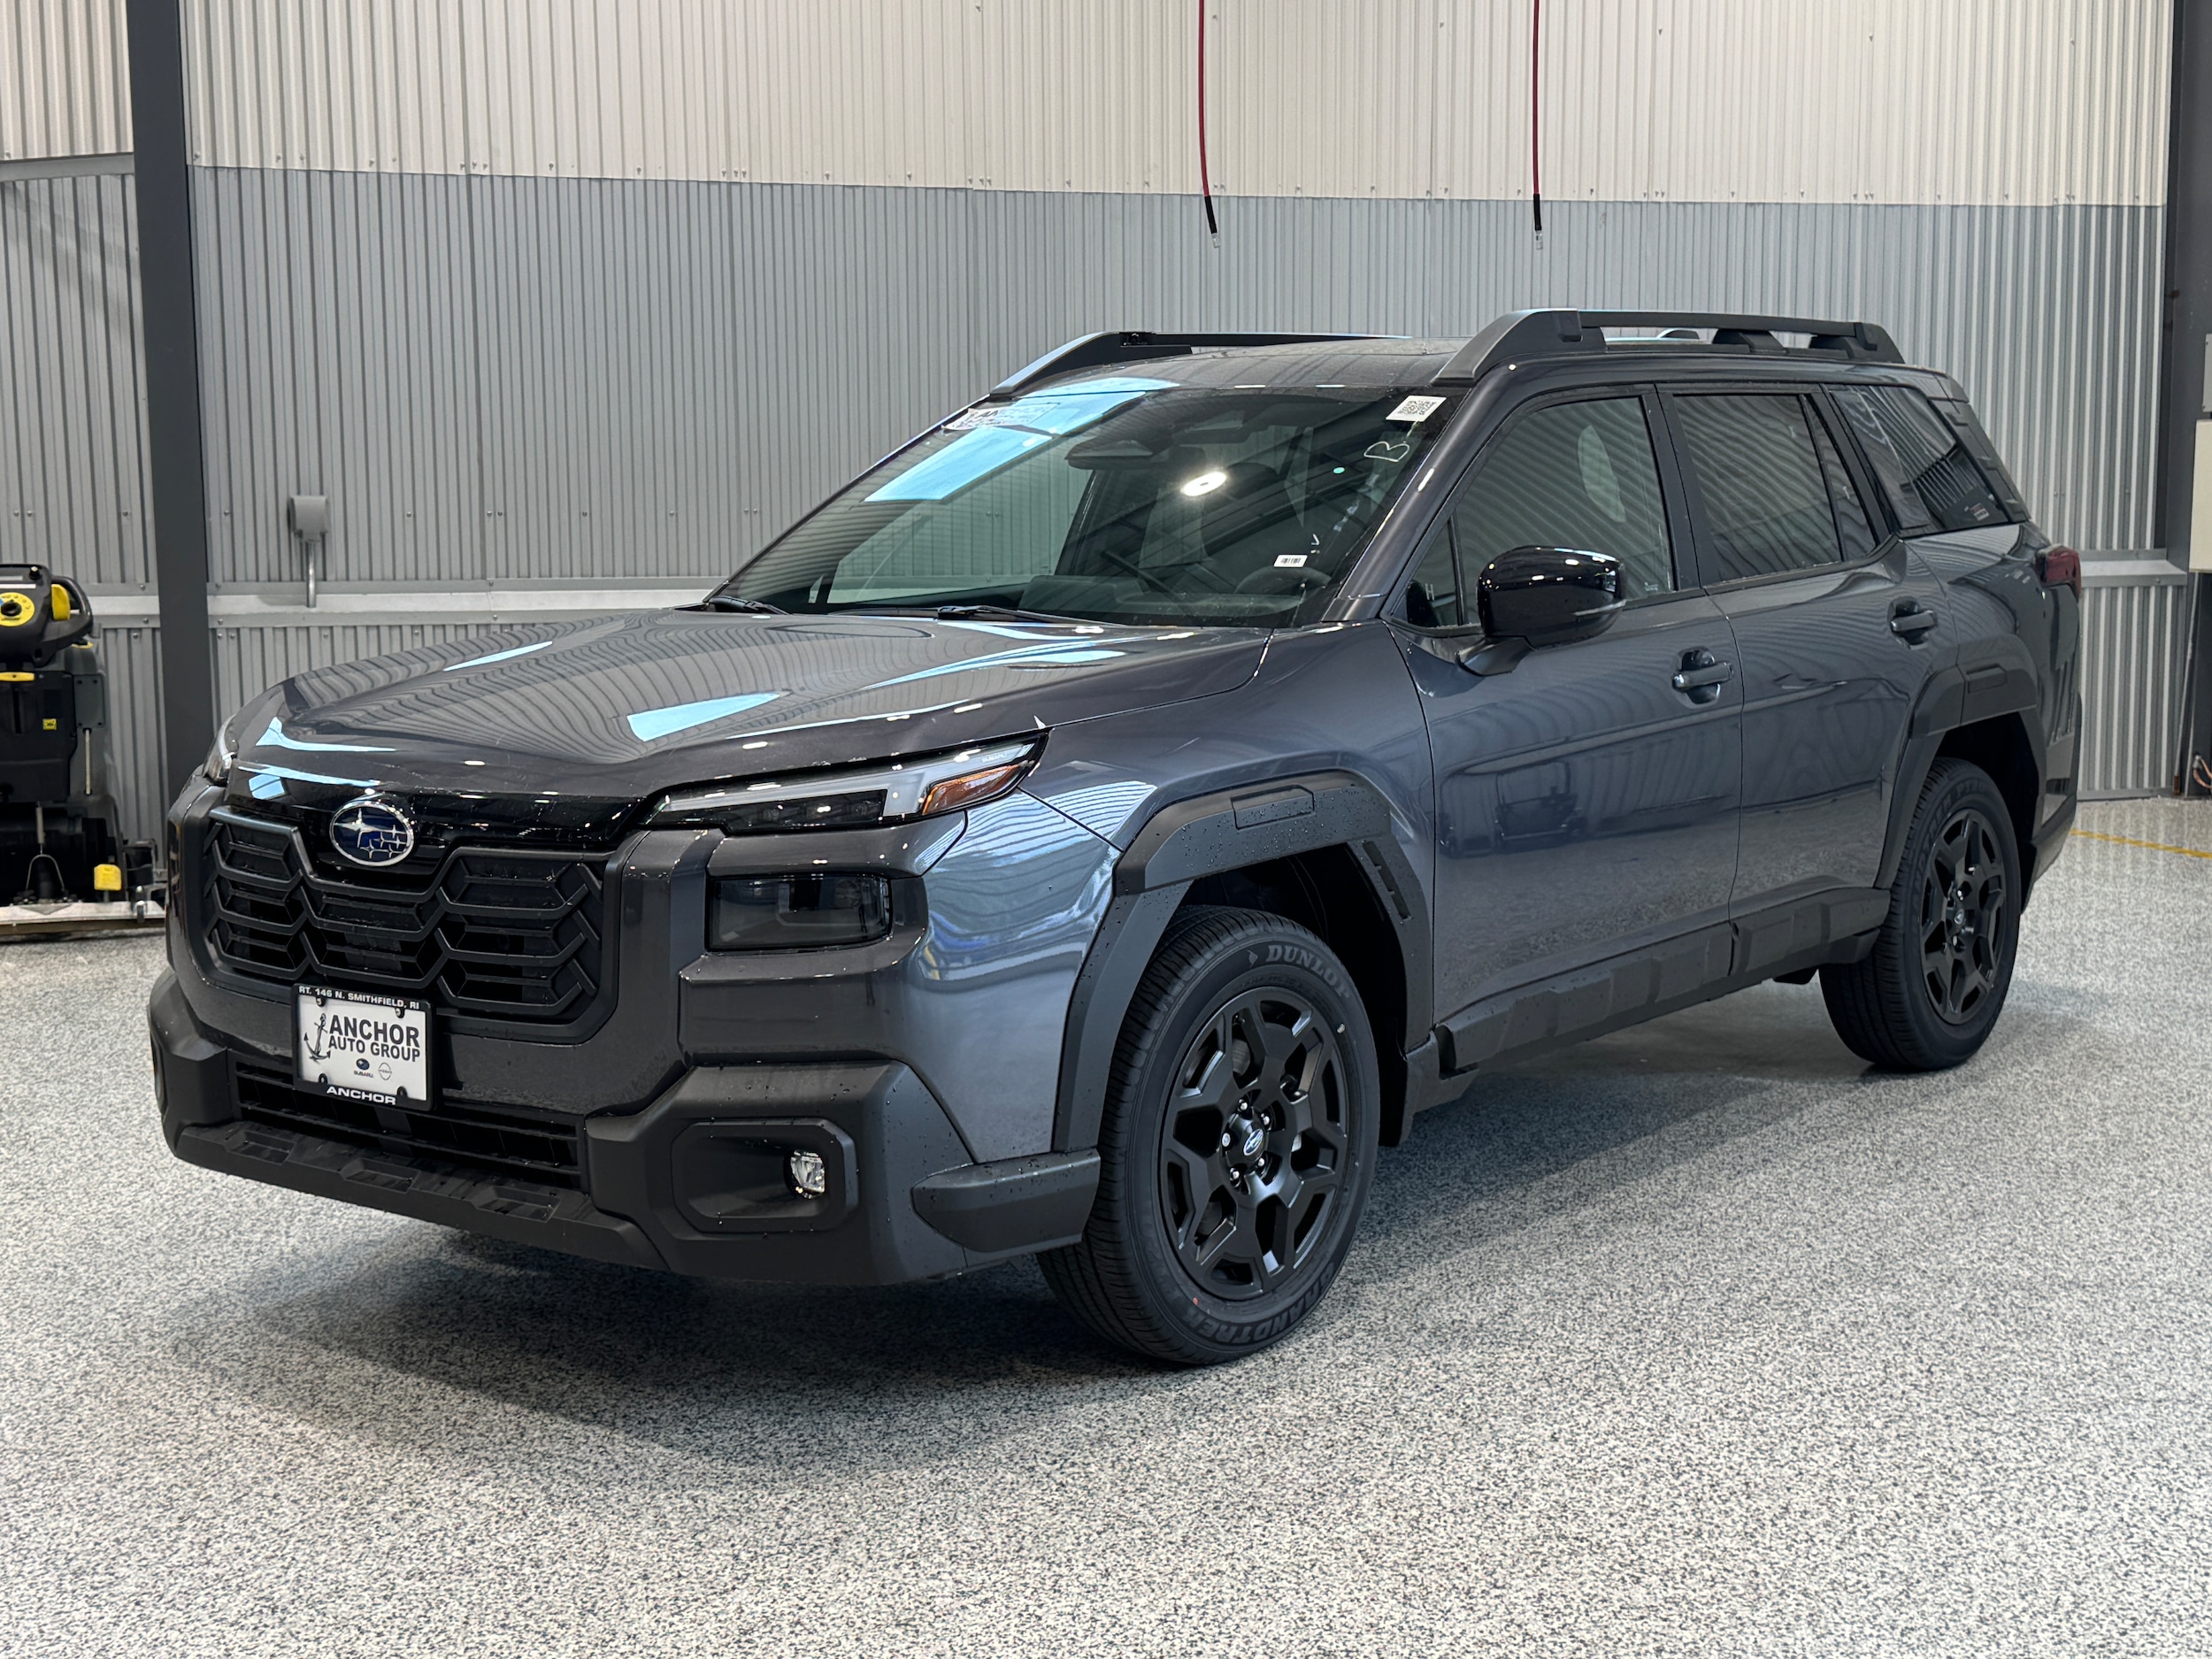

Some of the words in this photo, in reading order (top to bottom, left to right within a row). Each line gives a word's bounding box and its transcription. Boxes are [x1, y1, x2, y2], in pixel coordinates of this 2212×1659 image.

[1265, 944, 1349, 999] DUNLOP
[298, 986, 311, 995] RT.
[315, 987, 333, 998] 146
[334, 990, 345, 999] N.
[410, 1001, 419, 1010] RI
[329, 1014, 420, 1048] ANCHOR
[328, 1035, 365, 1054] AUTO
[370, 1042, 420, 1063] GROUP
[326, 1086, 396, 1106] ANCHOR
